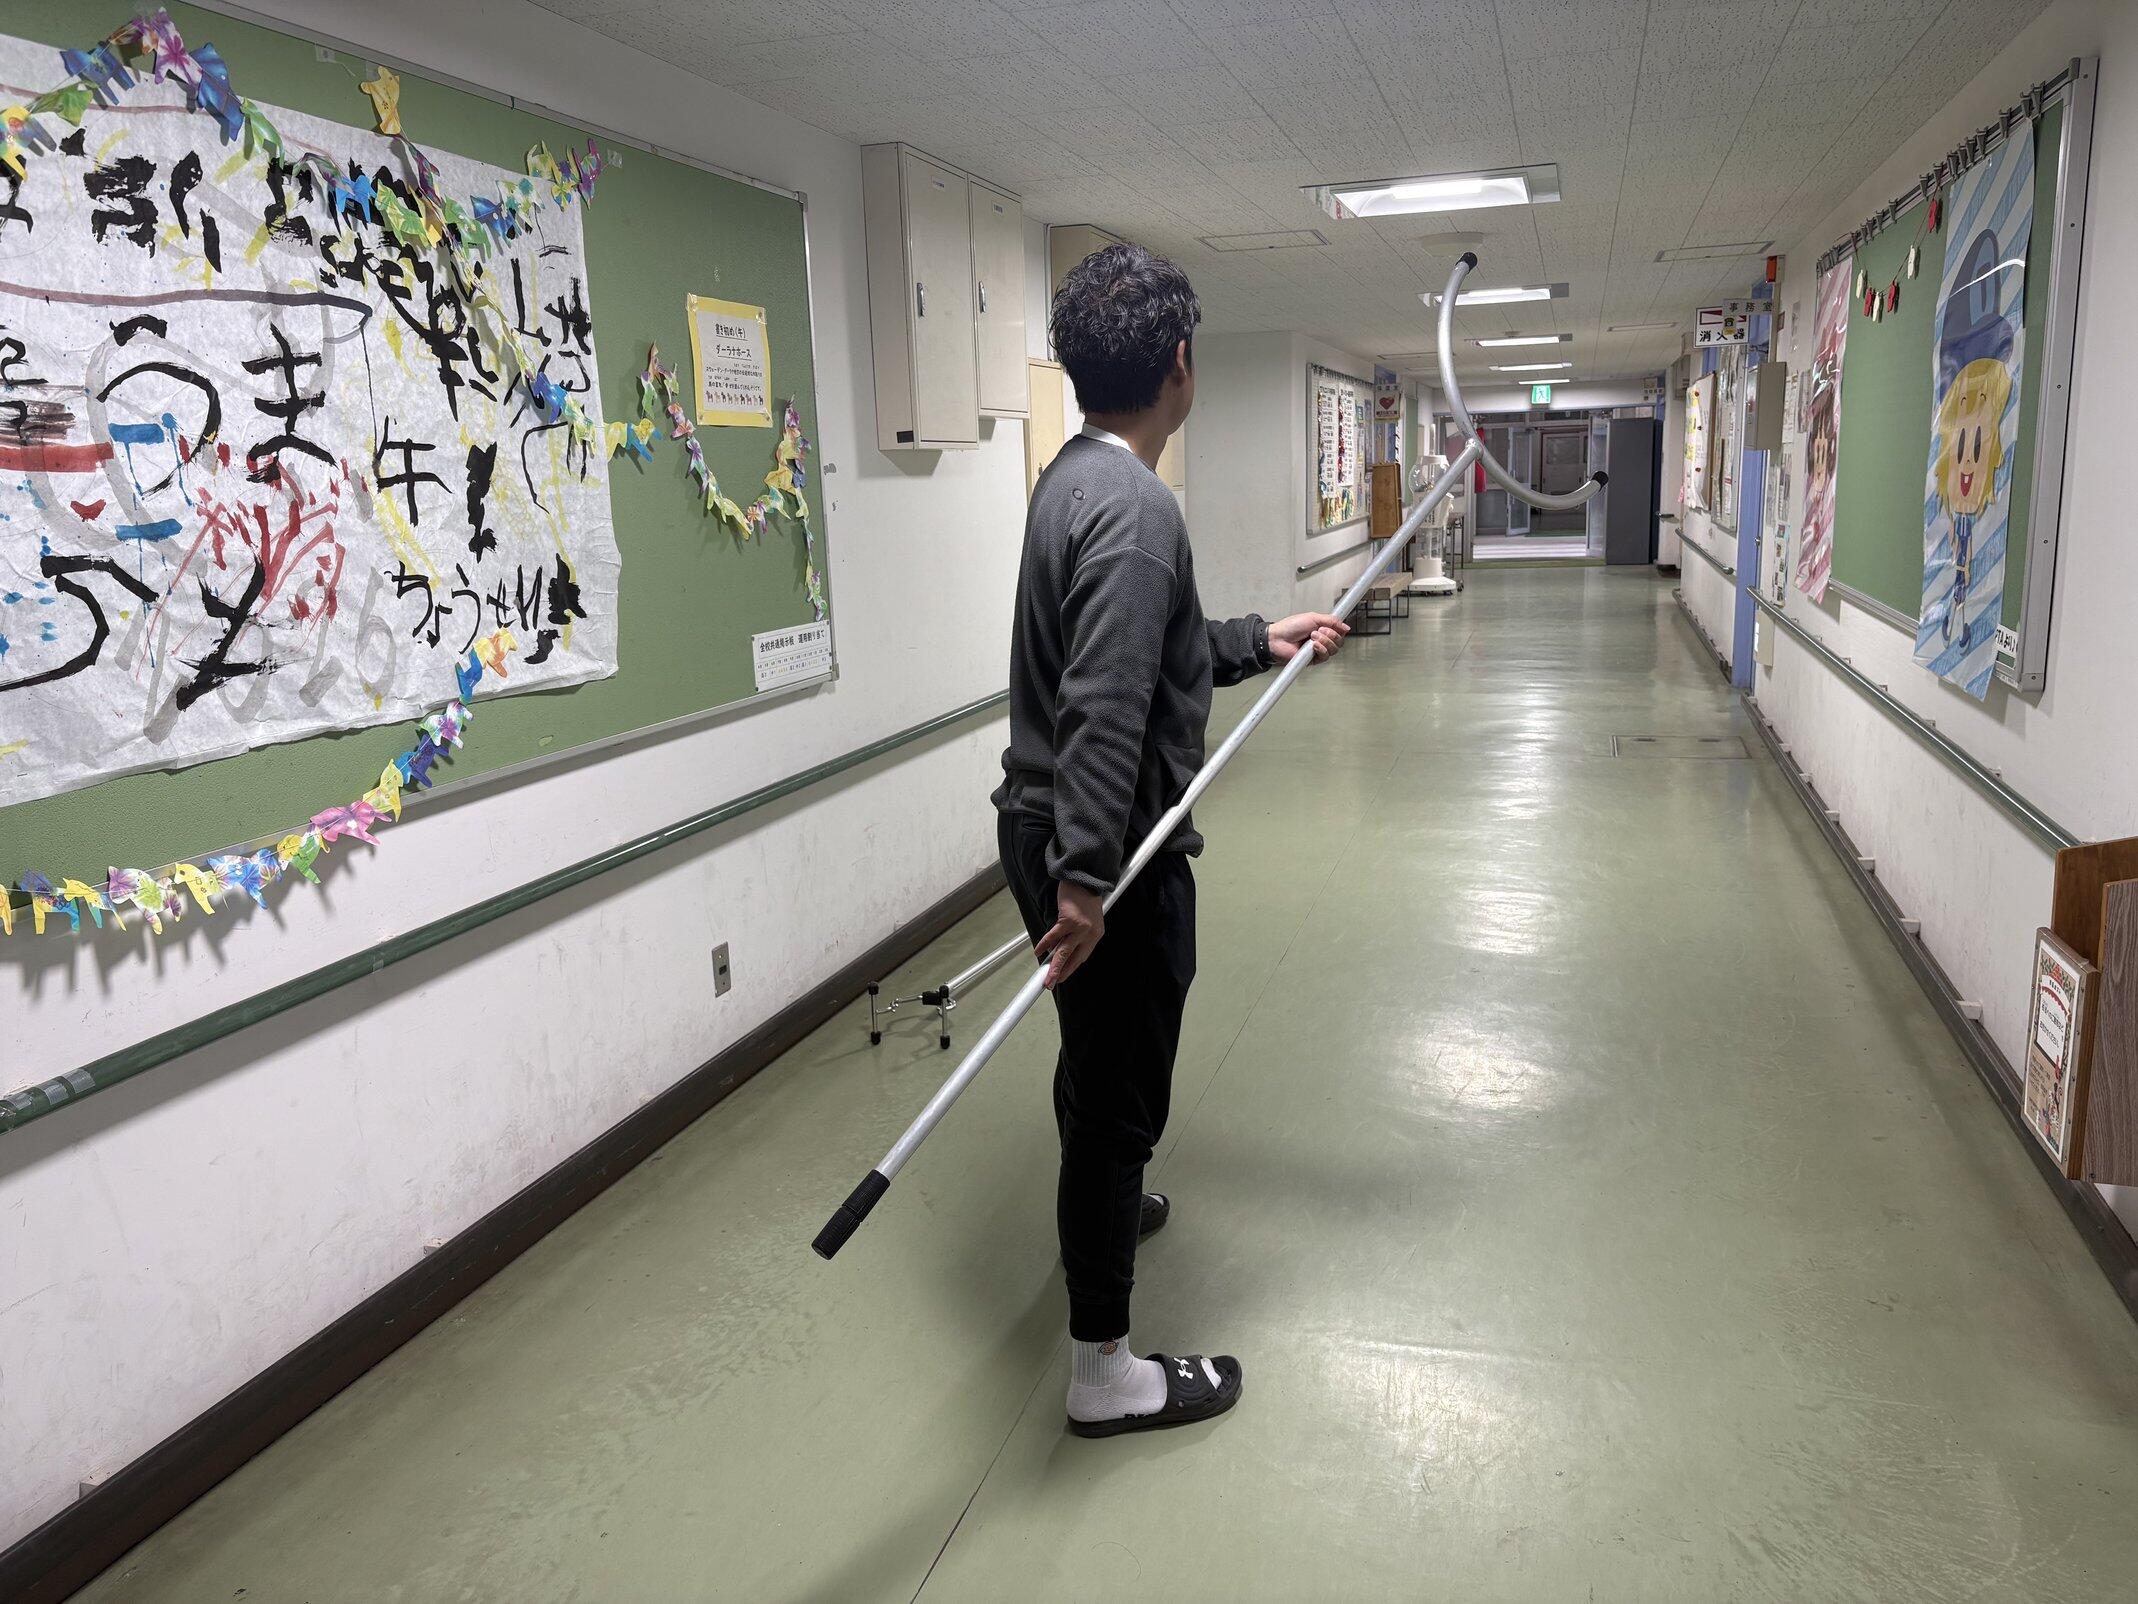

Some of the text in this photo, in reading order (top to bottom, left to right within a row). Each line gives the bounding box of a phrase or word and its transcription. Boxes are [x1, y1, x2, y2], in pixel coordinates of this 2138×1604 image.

[1729, 301, 1773, 312] 事務室
[716, 343, 752, 358] ダーラナホース
[760, 636, 795, 653] 全校共通掲示板
